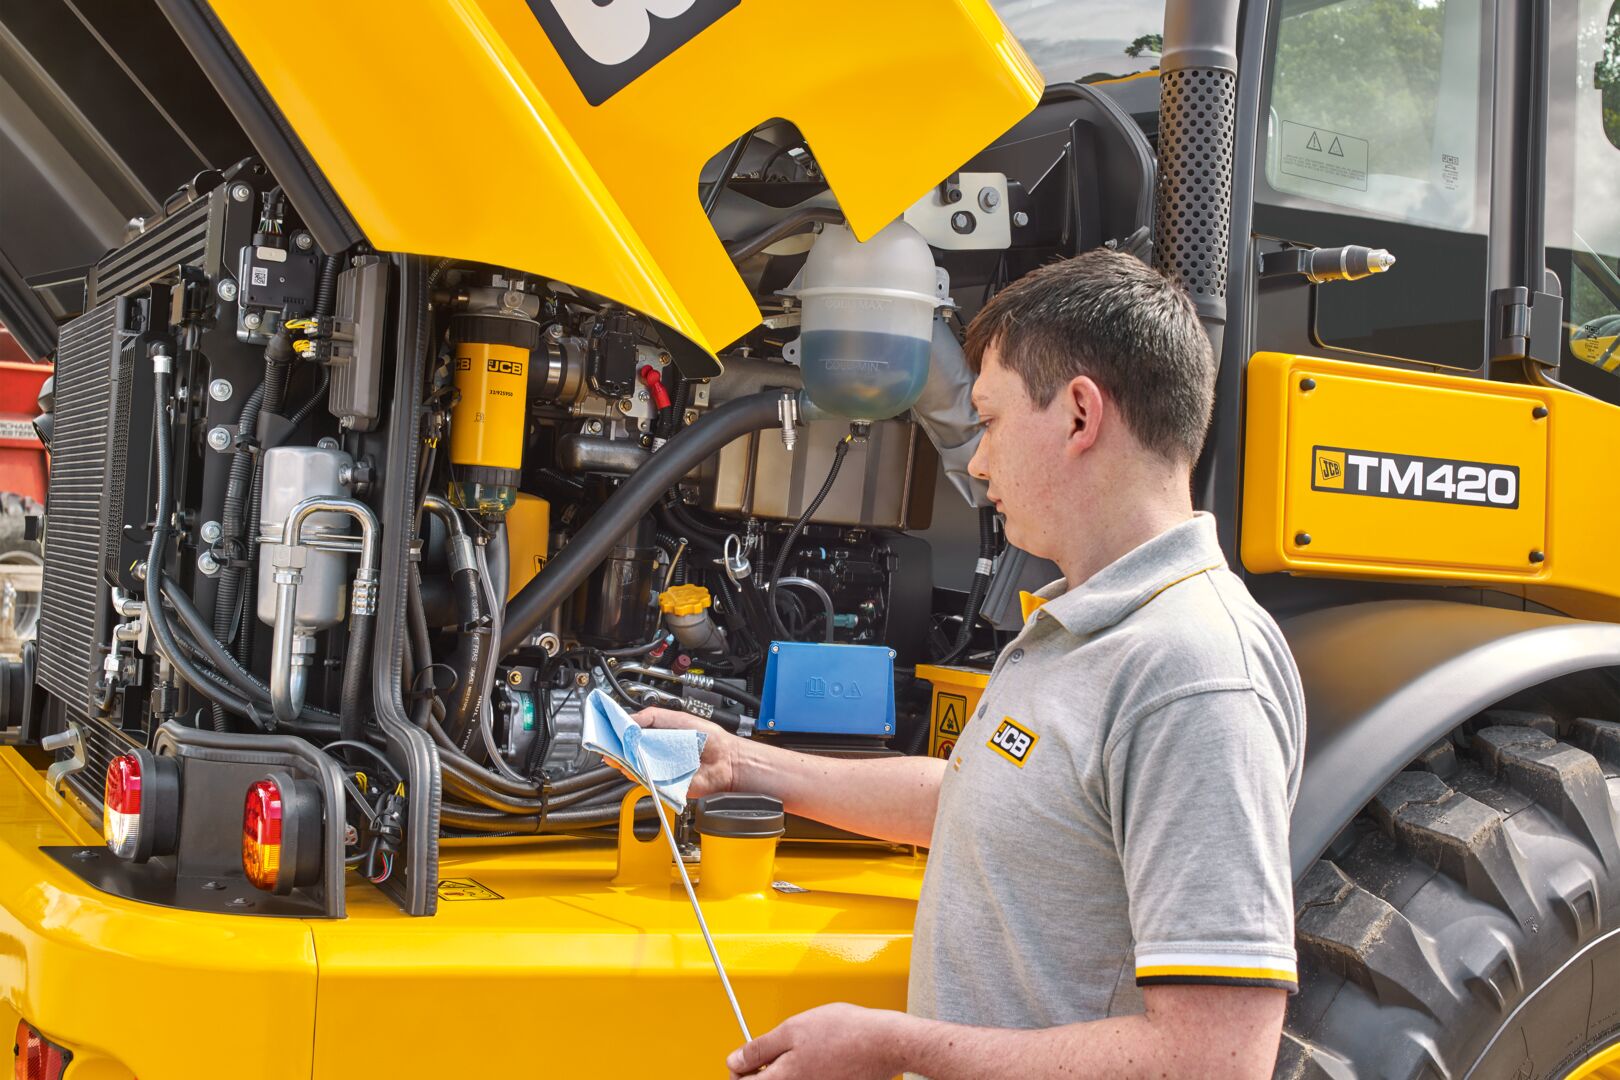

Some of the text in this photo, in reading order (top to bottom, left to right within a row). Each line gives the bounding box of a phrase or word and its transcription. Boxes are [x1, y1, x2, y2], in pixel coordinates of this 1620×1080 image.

[488, 360, 523, 375] JCB
[1322, 459, 1341, 478] JCB
[1347, 454, 1517, 505] TM420
[992, 724, 1032, 759] JCB
